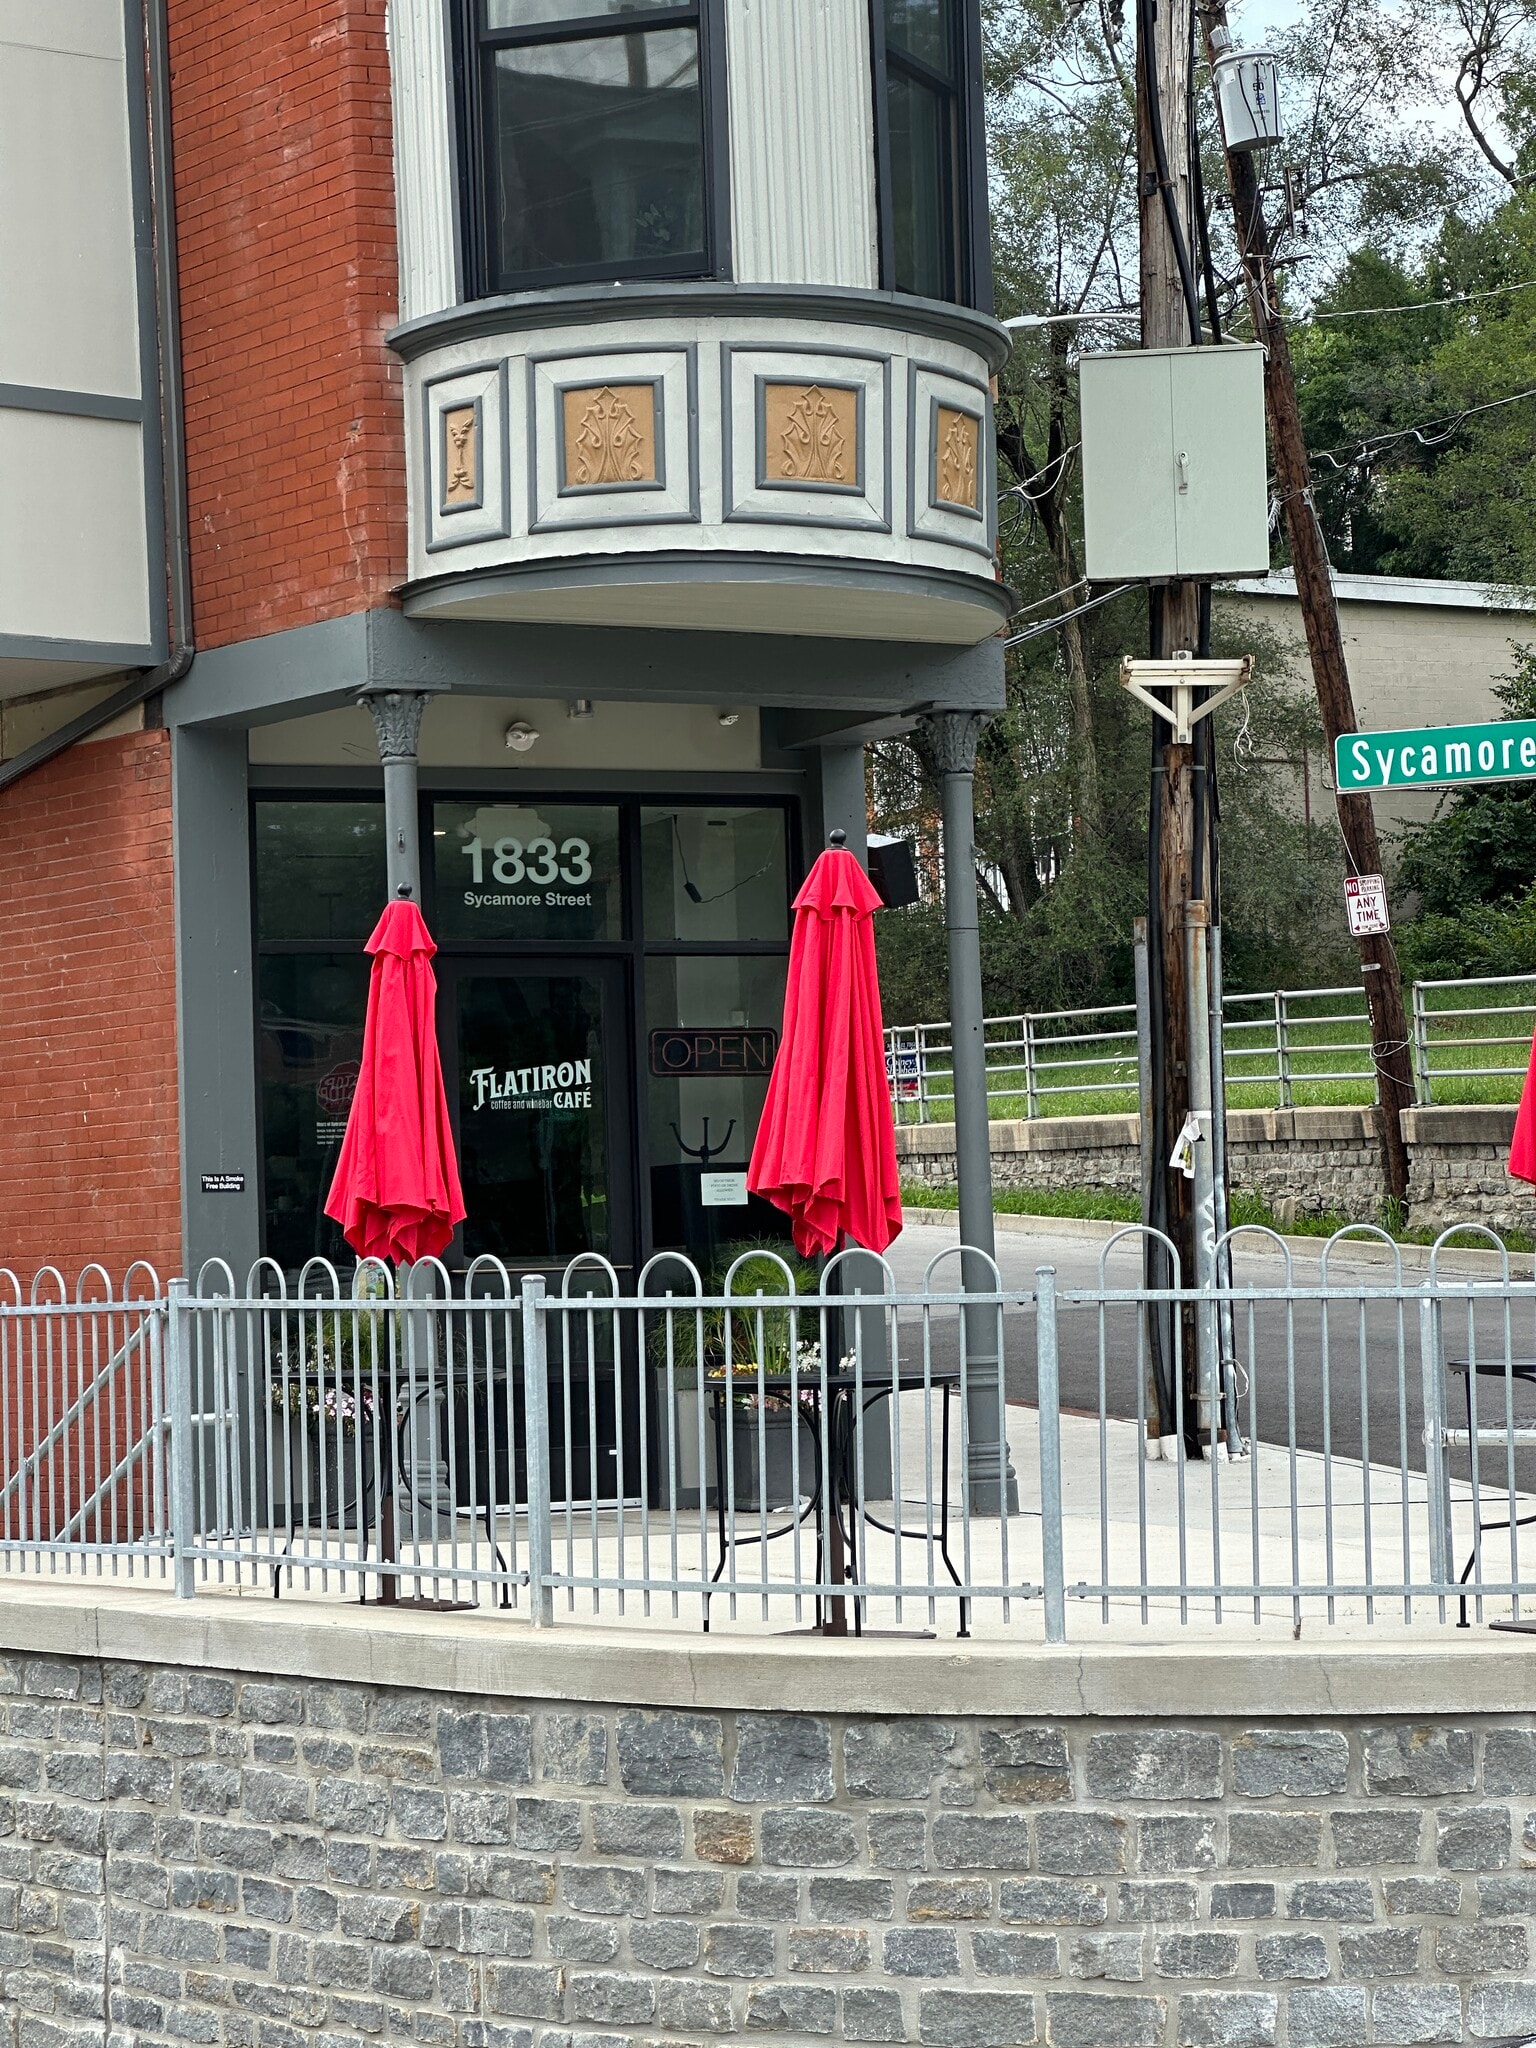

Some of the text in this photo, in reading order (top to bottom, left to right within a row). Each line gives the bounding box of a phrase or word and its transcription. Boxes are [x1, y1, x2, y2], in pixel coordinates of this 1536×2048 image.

[1351, 736, 1536, 785] Sycamore
[461, 837, 592, 885] 1833
[1346, 882, 1358, 894] NO
[464, 891, 592, 908] Sycamore Street
[1356, 896, 1377, 909] ANY
[1356, 909, 1380, 922] TIME
[662, 1037, 766, 1068] OPEN
[469, 1058, 592, 1111] FLATIRON
[490, 1098, 552, 1110] coffee and winebar
[553, 1086, 592, 1109] CAFÉ
